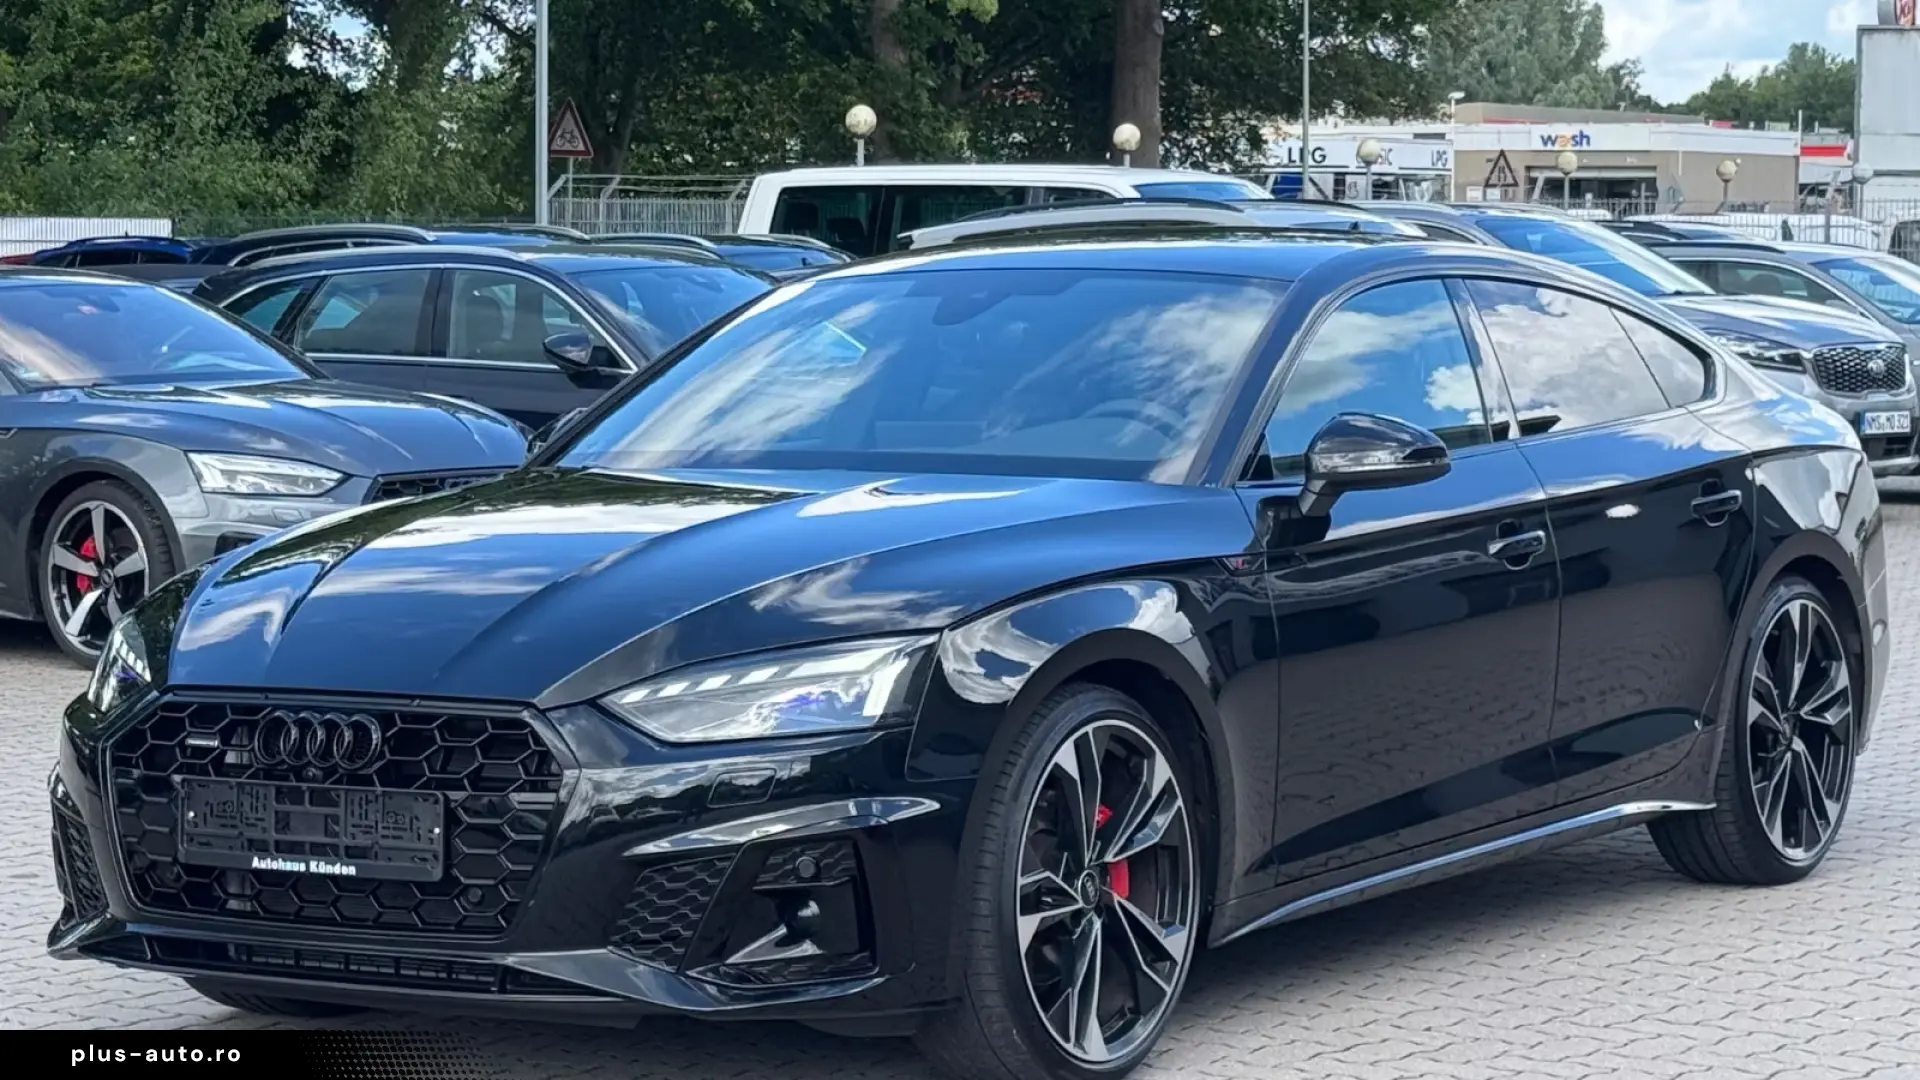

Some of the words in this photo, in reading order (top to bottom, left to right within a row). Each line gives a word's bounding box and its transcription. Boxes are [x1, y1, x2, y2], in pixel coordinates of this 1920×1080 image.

[1540, 129, 1591, 147] wash
[1431, 149, 1448, 168] LPG
[252, 856, 306, 872] Autohaus
[309, 860, 356, 876] Künden
